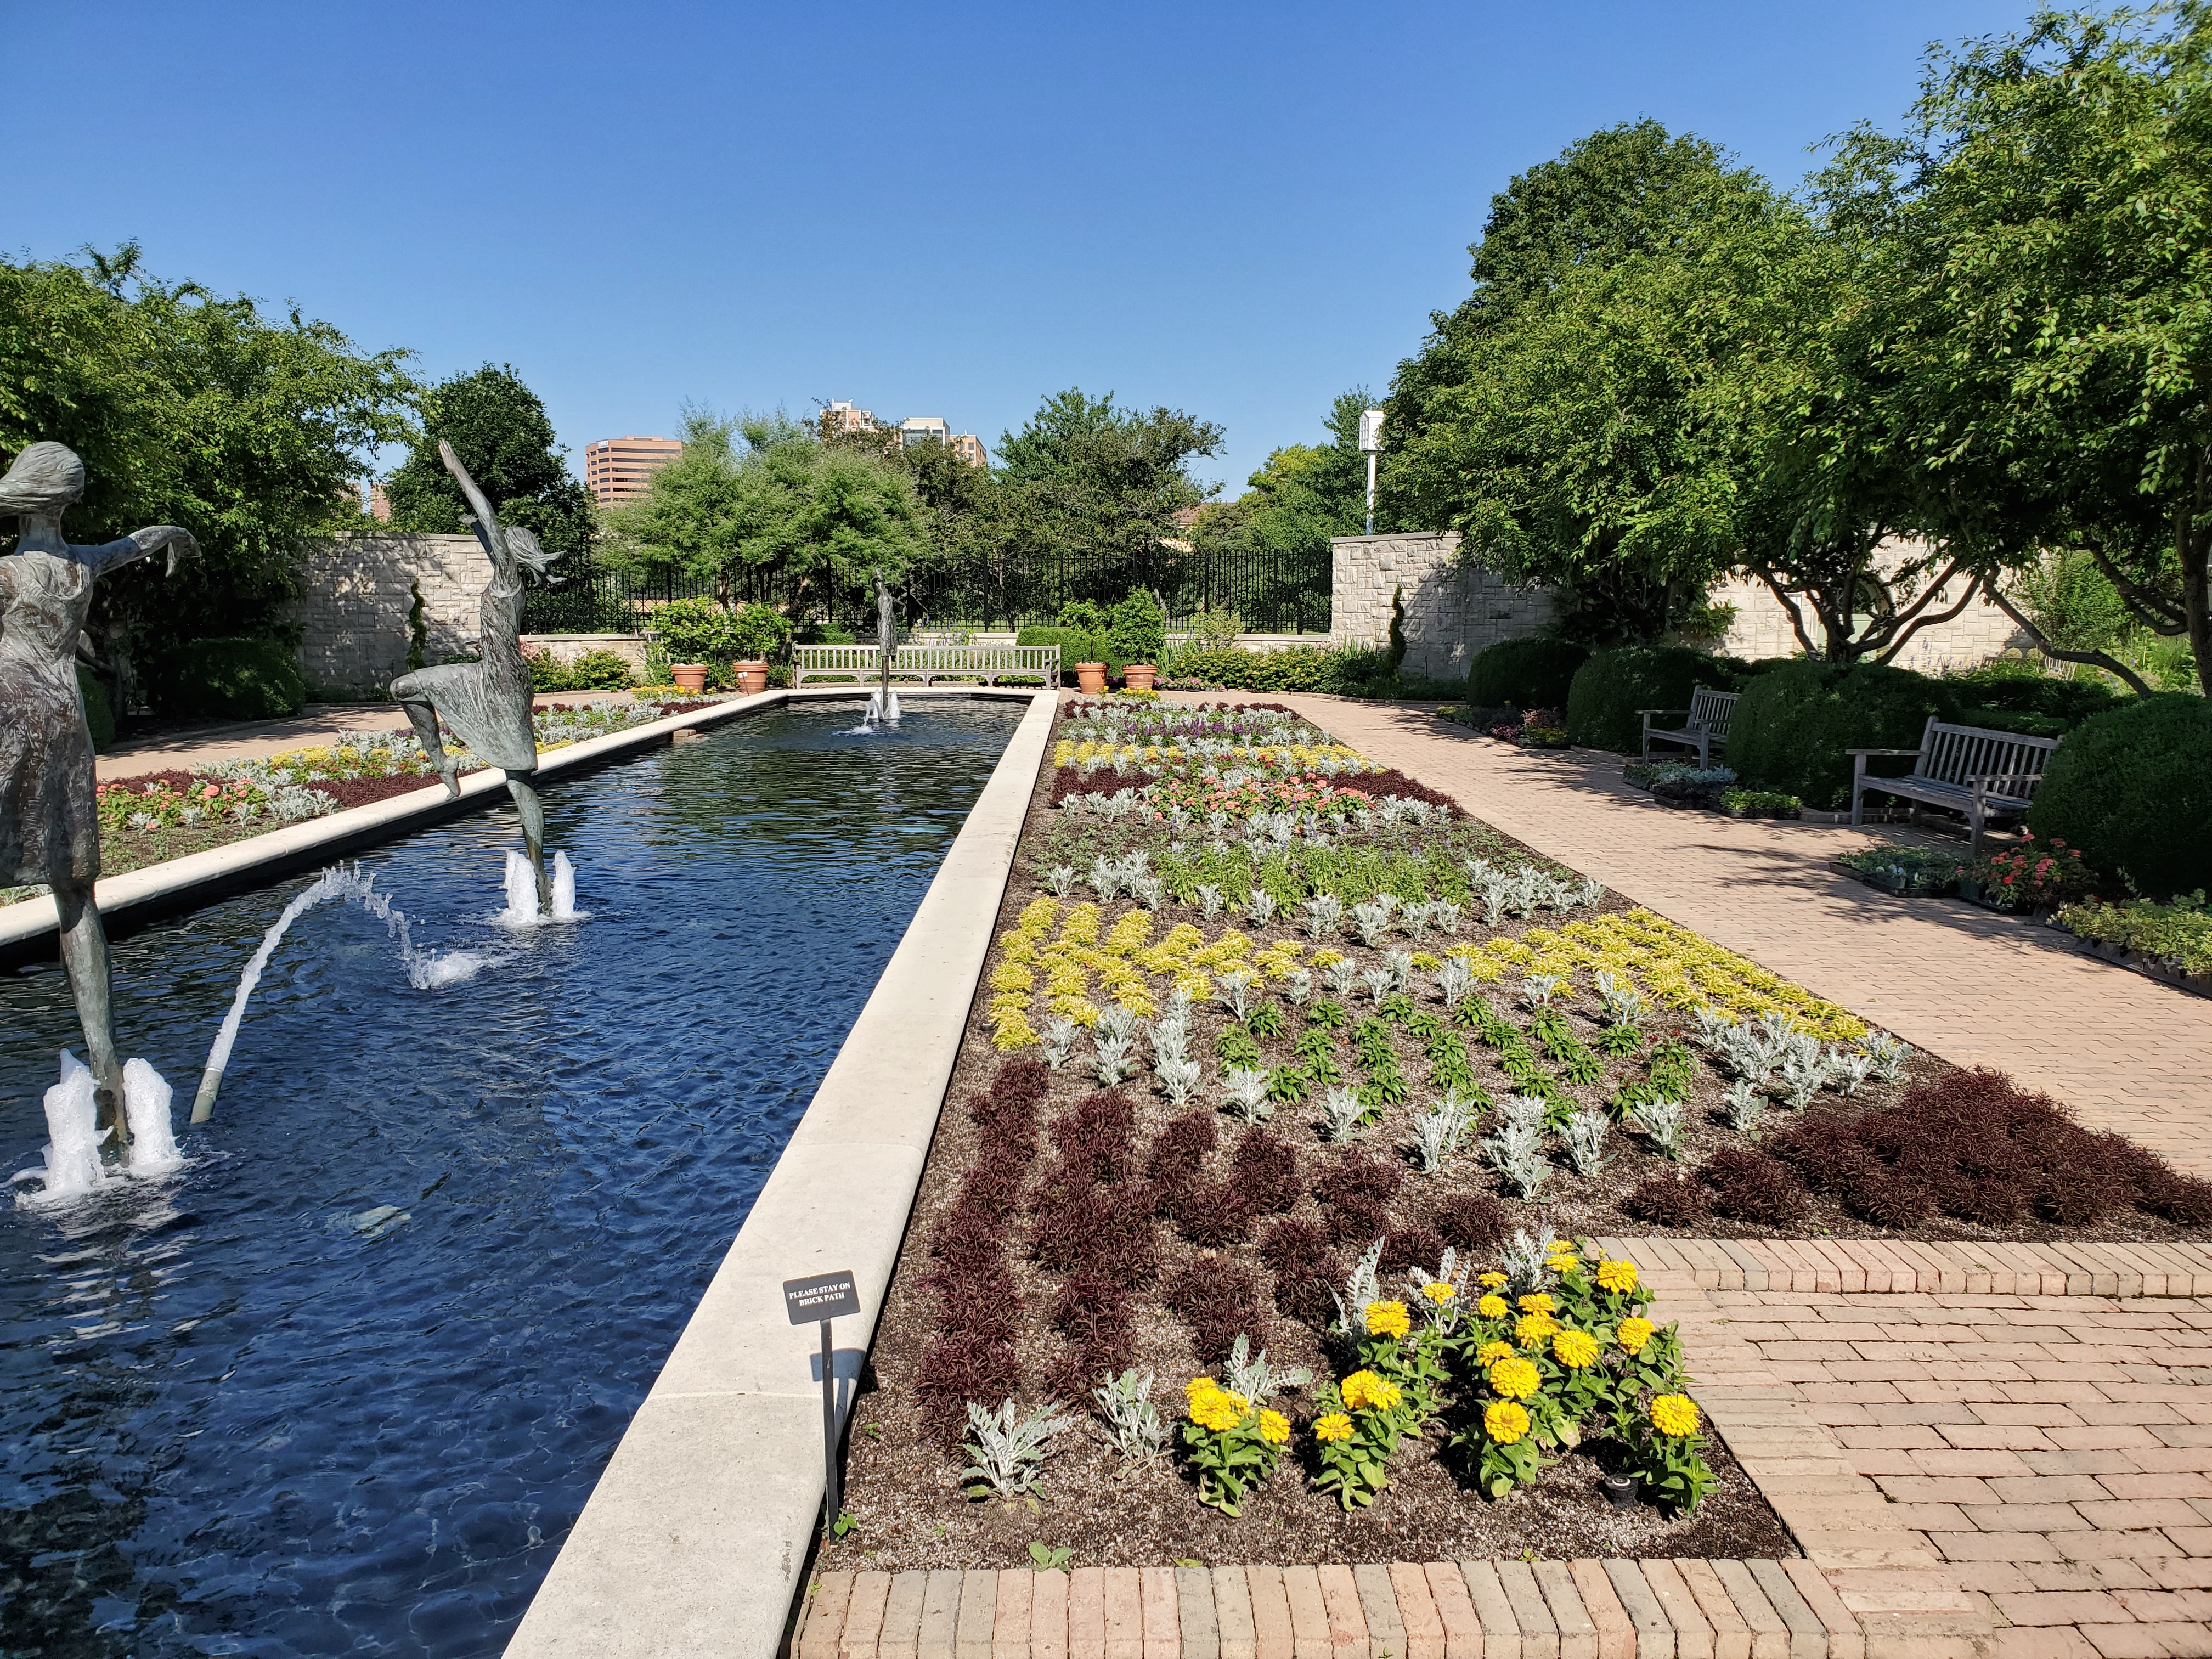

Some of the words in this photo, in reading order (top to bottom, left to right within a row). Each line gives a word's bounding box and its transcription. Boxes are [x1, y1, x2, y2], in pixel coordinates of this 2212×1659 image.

[789, 1288, 818, 1299] PLEASE
[819, 1284, 838, 1293] STAY
[799, 1295, 824, 1306] BRICK
[824, 1292, 845, 1301] PATH
